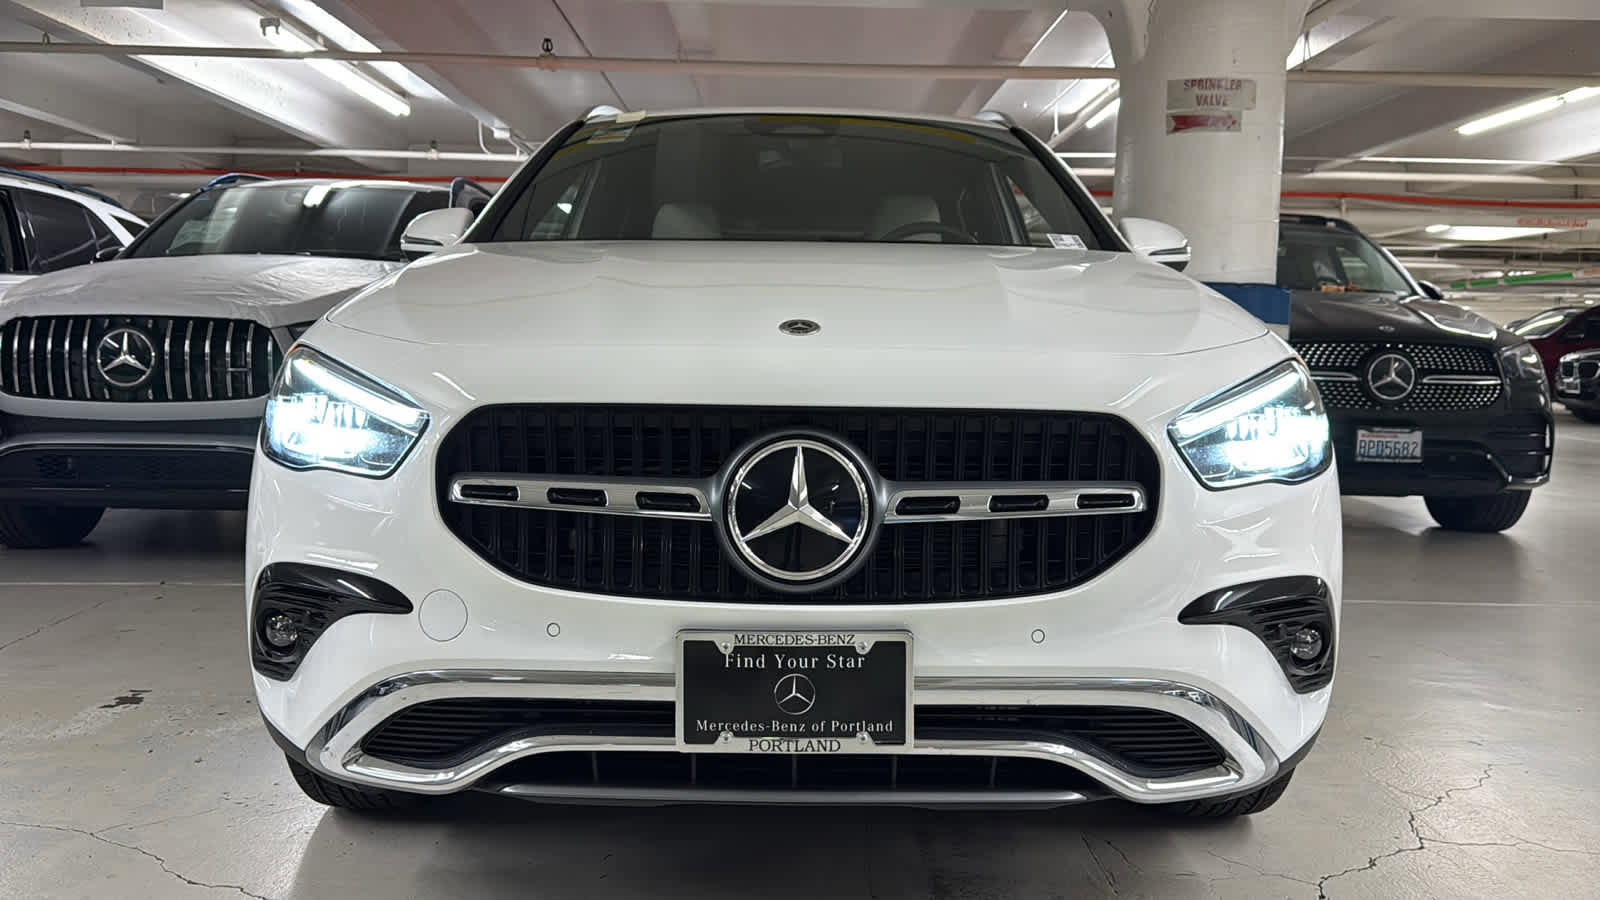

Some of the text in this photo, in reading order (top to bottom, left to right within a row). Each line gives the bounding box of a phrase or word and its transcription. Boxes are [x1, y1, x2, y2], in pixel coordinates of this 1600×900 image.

[1195, 95, 1228, 107] VALVE
[734, 634, 856, 646] MERCEDES-BENZ
[724, 653, 866, 669] Find Your Star
[696, 719, 894, 733] Mercedes-Benz of Portland
[750, 739, 841, 752] PORTLAND
